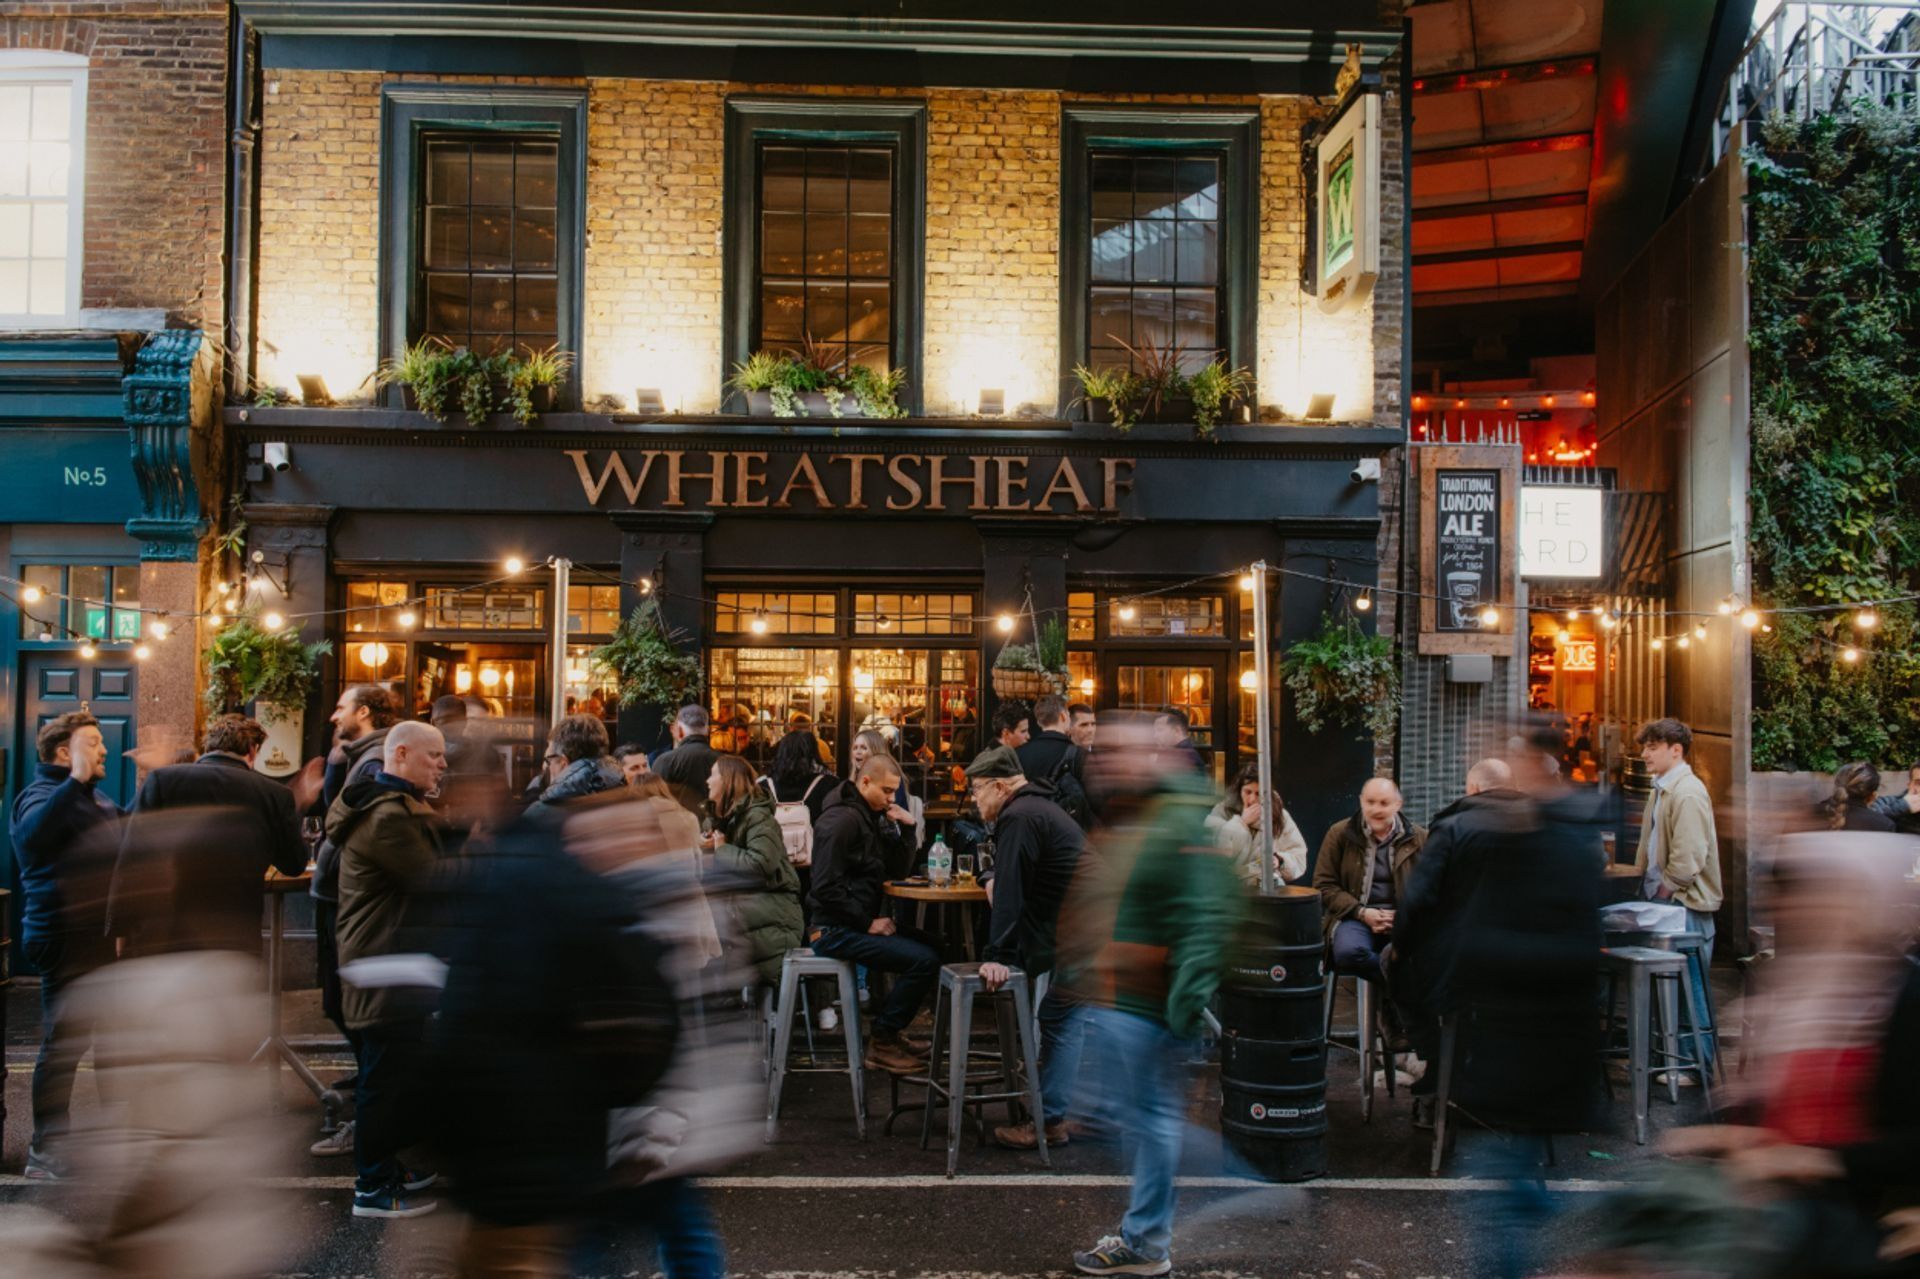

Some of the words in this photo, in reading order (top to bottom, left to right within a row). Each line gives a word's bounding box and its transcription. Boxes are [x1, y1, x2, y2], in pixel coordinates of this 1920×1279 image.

[563, 450, 1137, 511] WHEATSHEAF
[1441, 478, 1494, 492] TRADITIONAL
[1440, 494, 1494, 512] LONDON
[1524, 501, 1571, 527] HE
[1443, 514, 1484, 536] ALE
[1519, 539, 1588, 564] ARD
